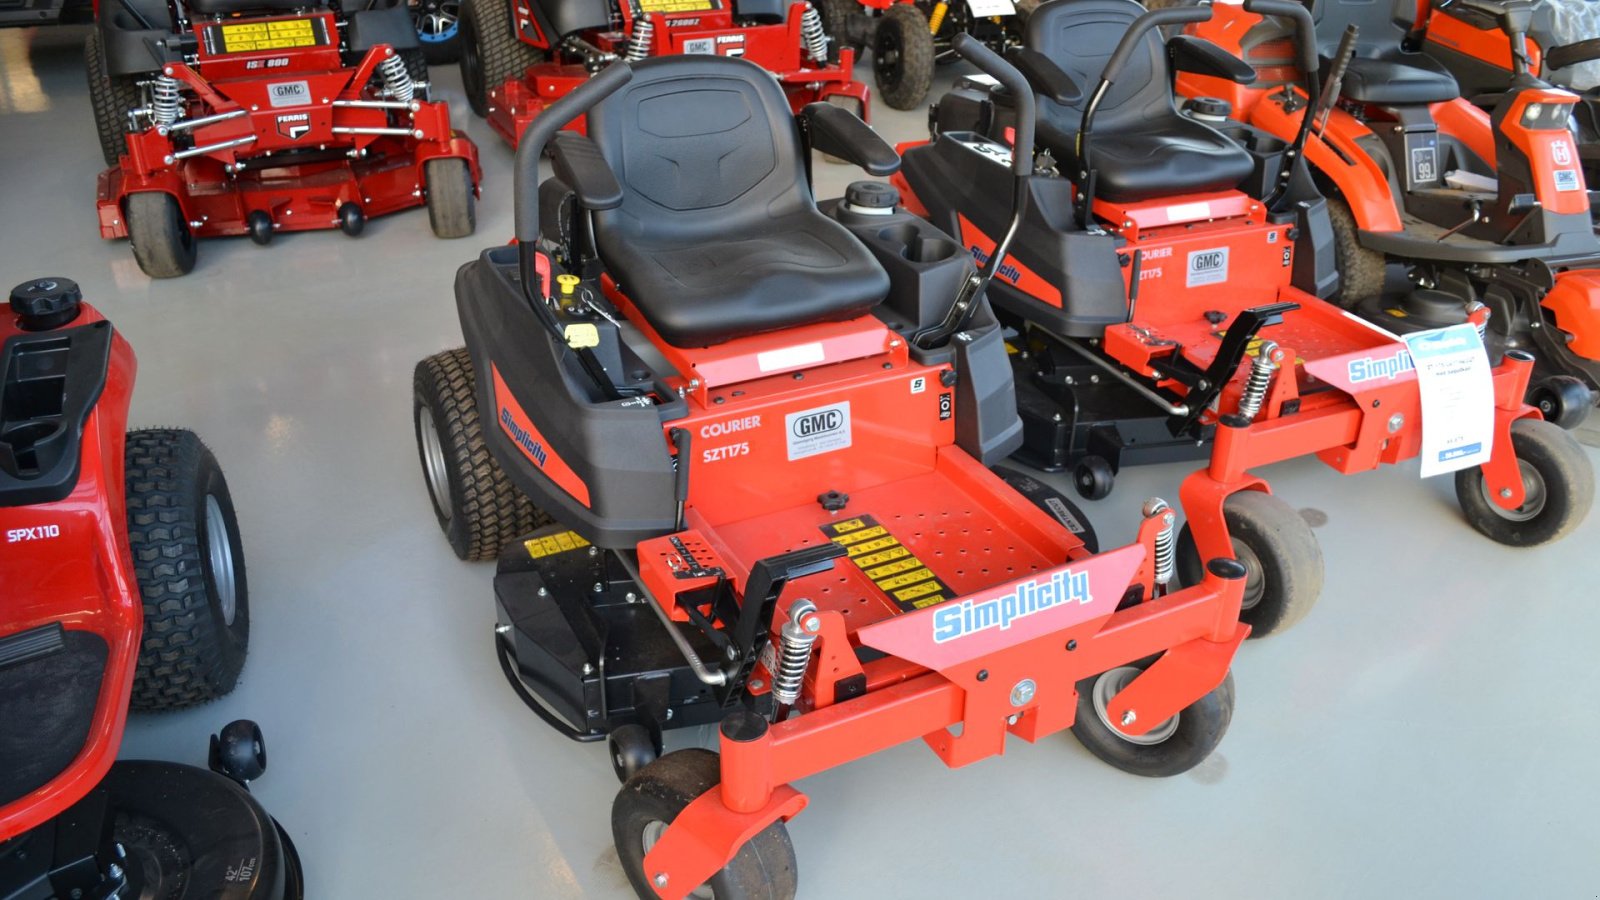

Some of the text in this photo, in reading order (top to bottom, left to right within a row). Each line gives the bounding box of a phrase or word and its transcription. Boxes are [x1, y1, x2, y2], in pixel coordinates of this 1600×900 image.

[266, 57, 289, 68] 800
[277, 84, 301, 97] GMC
[277, 113, 309, 123] FERRIS
[1418, 162, 1431, 179] 99
[1141, 247, 1173, 261] OURIER
[1196, 254, 1220, 269] GMC
[1347, 349, 1416, 384] Simpli
[700, 415, 761, 438] COURIER
[799, 411, 837, 436] GMC
[501, 407, 548, 468] Simplicity
[702, 442, 750, 463] SZT175
[7, 524, 60, 543] SPX110
[933, 569, 1093, 644] Simplicity
